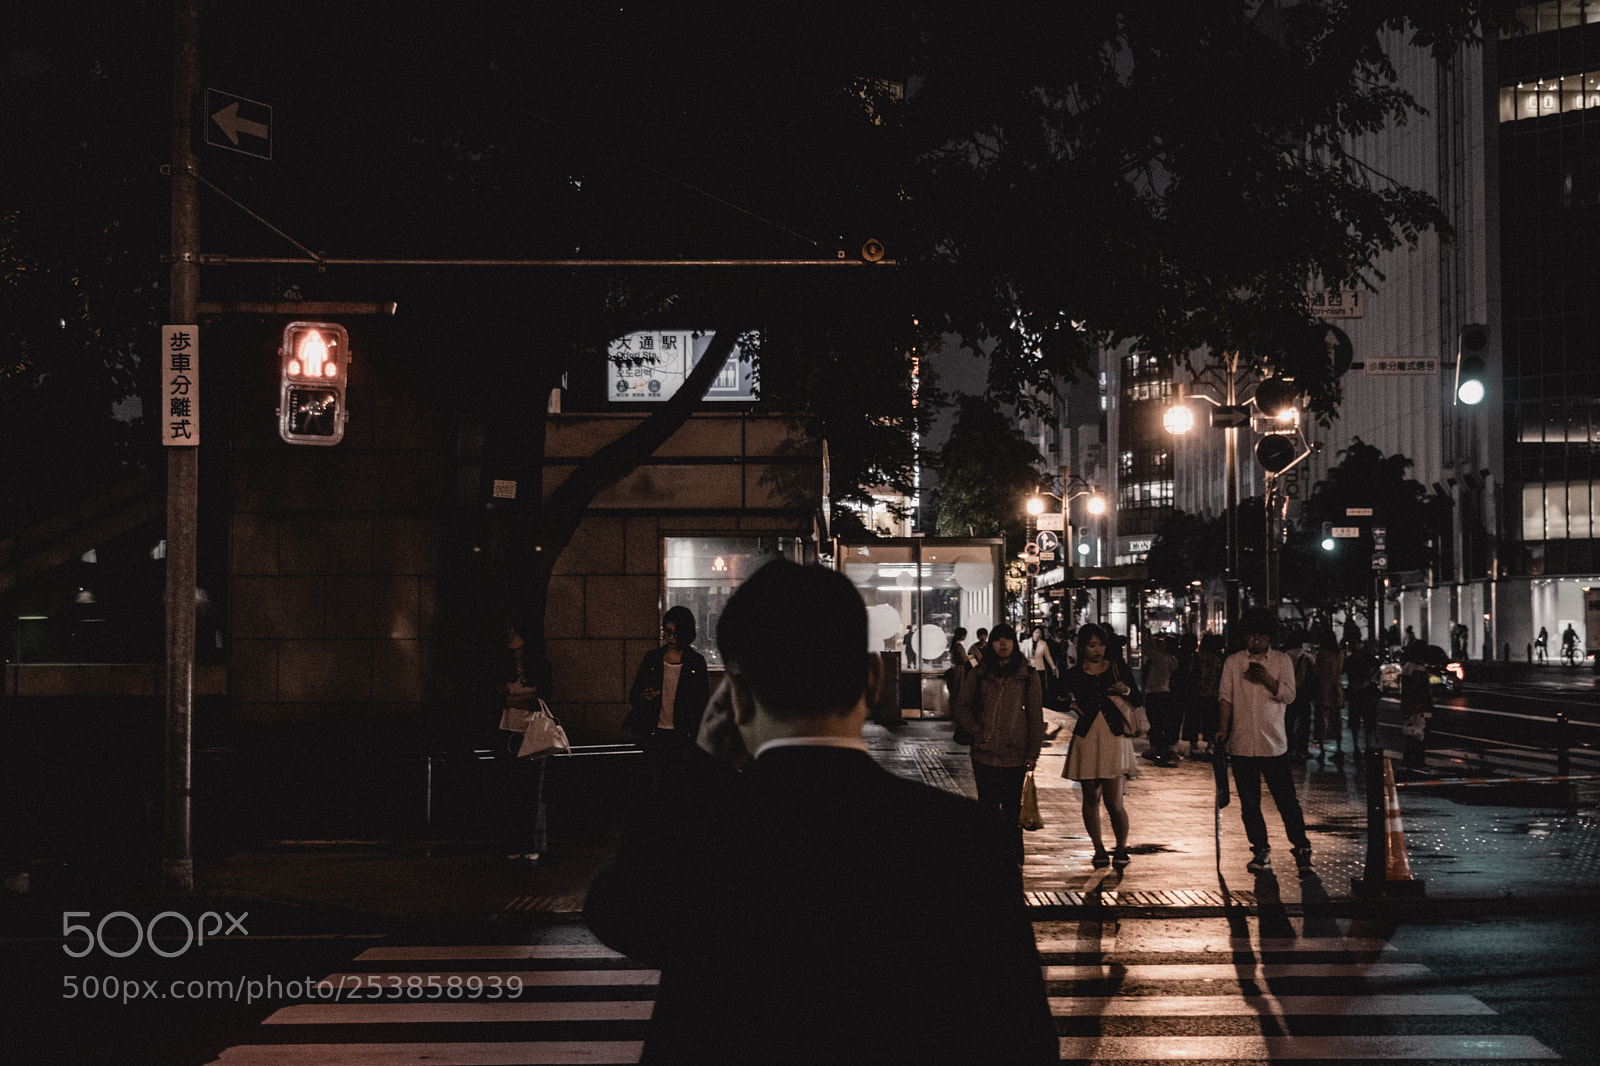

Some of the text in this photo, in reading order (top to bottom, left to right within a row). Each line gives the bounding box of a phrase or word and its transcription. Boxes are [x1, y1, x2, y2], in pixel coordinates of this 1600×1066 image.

[1351, 292, 1358, 307] 1
[1350, 307, 1354, 315] 1
[616, 335, 677, 350] 大通駅
[1368, 360, 1435, 371] 歩車分離式信号
[170, 331, 192, 439] 歩車分離式
